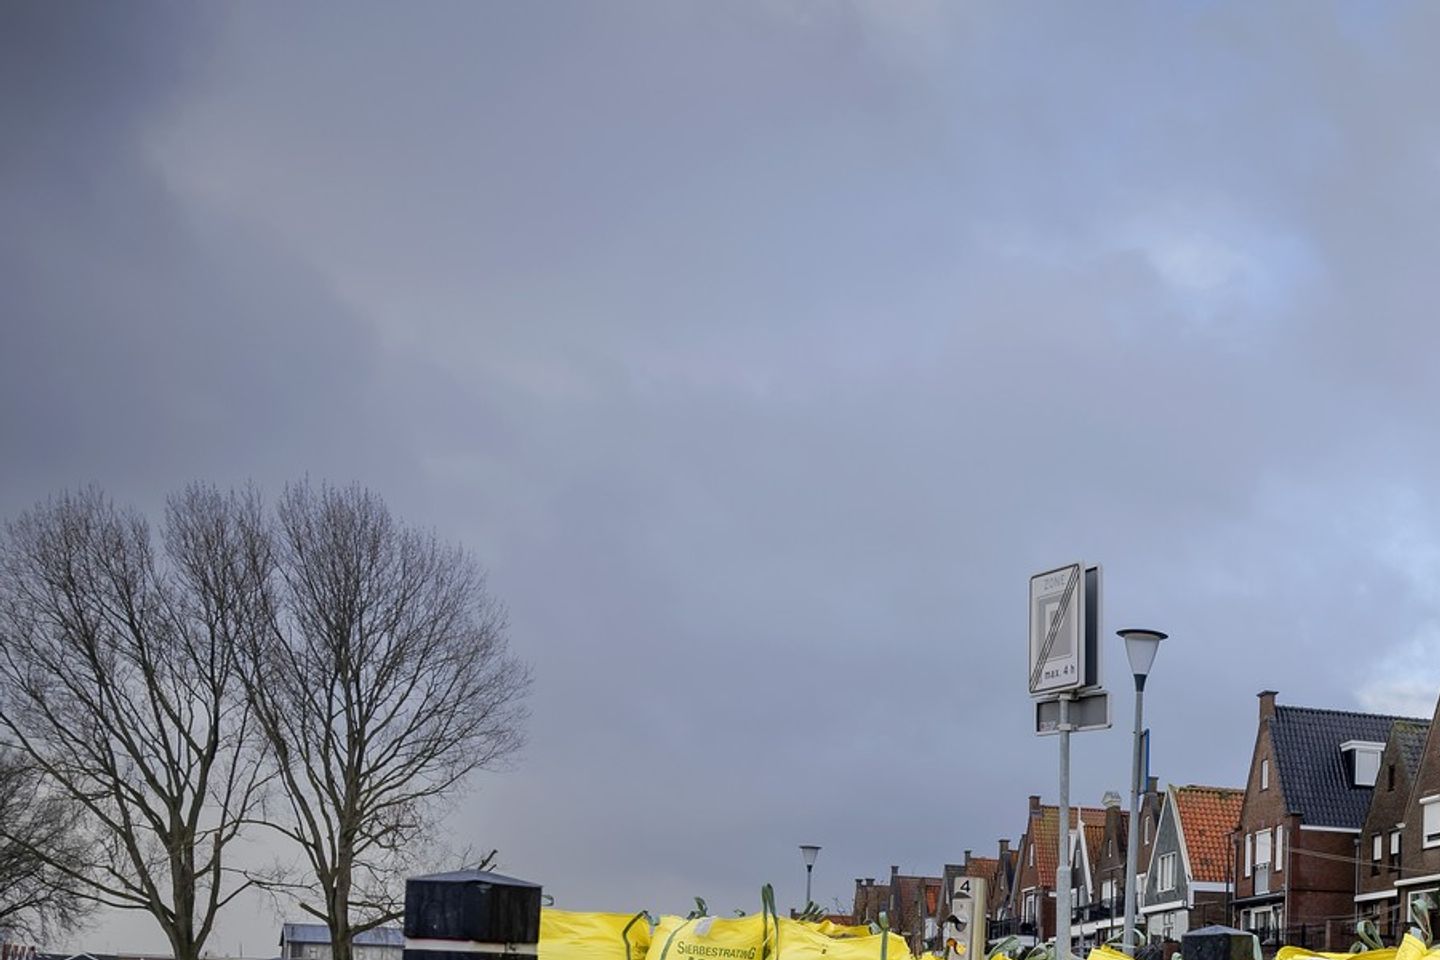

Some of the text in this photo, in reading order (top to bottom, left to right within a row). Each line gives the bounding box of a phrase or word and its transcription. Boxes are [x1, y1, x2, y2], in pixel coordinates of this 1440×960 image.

[1063, 665, 1069, 676] 4
[960, 880, 970, 893] 4
[677, 941, 756, 960] SIERBESTRATING
